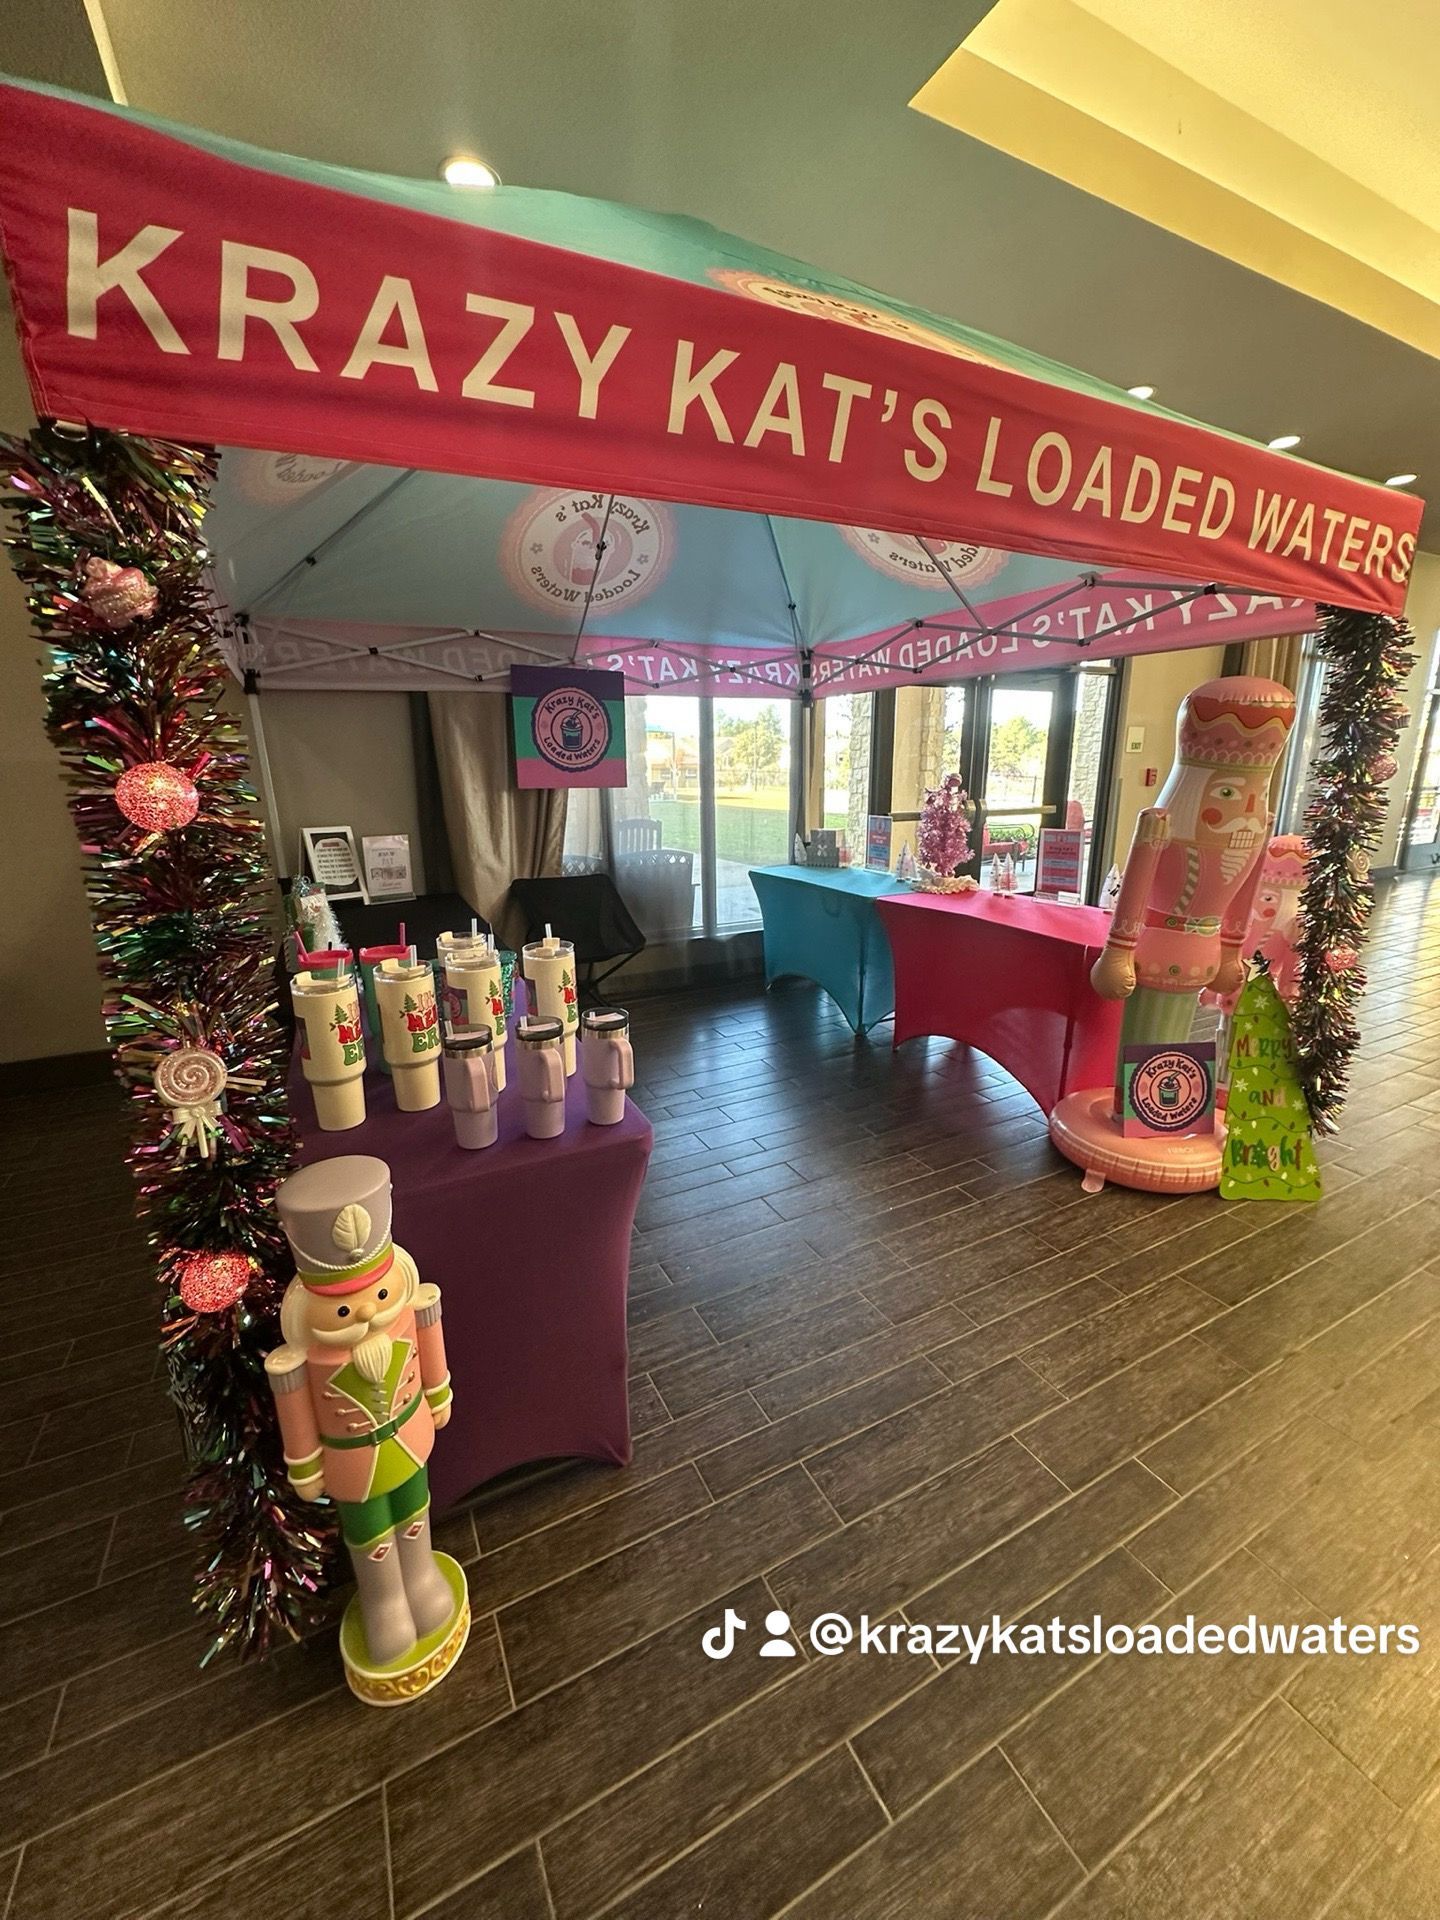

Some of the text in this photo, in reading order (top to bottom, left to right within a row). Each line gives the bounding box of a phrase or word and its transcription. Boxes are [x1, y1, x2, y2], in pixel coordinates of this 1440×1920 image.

[66, 207, 1417, 583] KRAZY KAT'S LOADED WATERS
[544, 696, 600, 720] Krazy Kat's
[543, 737, 601, 761] Loaded Waters
[1146, 1059, 1197, 1080] Krazy Kat's
[1141, 1097, 1198, 1121] Loaded Waters
